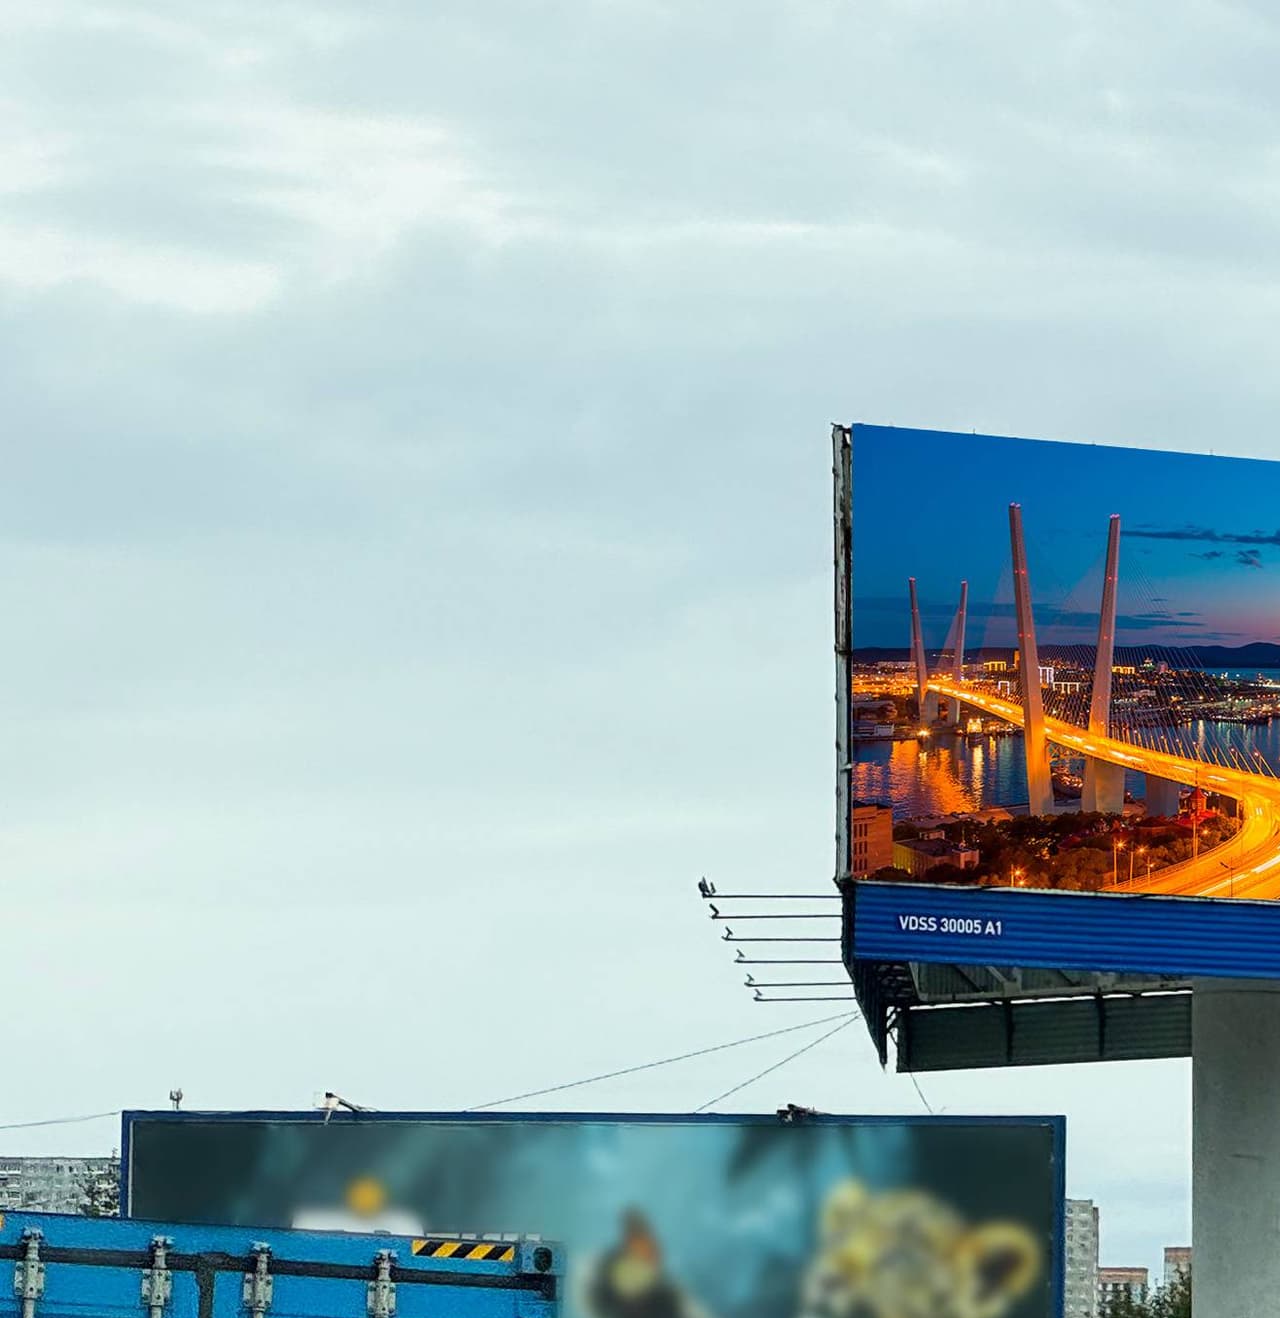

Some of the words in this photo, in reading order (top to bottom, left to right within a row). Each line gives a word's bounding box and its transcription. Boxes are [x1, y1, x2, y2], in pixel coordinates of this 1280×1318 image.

[899, 915, 937, 932] VDSS
[940, 917, 982, 935] 30005
[984, 921, 1002, 935] A1
